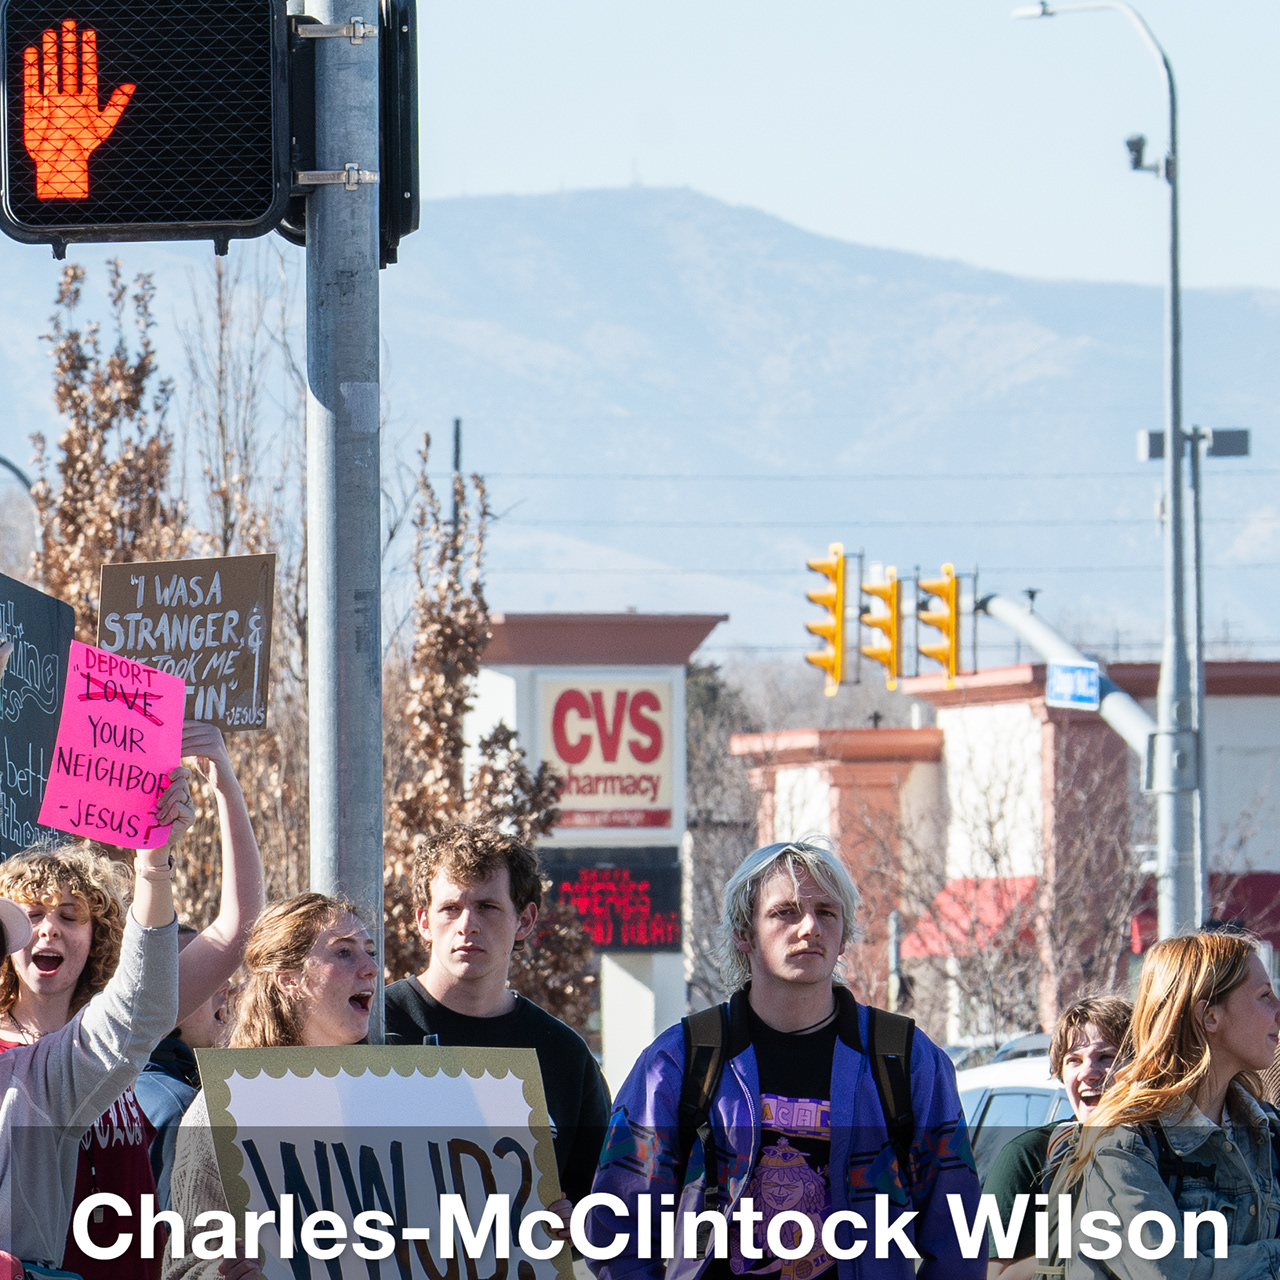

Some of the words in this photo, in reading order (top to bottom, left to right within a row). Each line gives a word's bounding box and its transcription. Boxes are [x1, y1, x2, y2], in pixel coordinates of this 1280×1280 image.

[86, 648, 158, 688] DEPORT
[88, 714, 147, 754] YOUR
[552, 688, 663, 764] CVS
